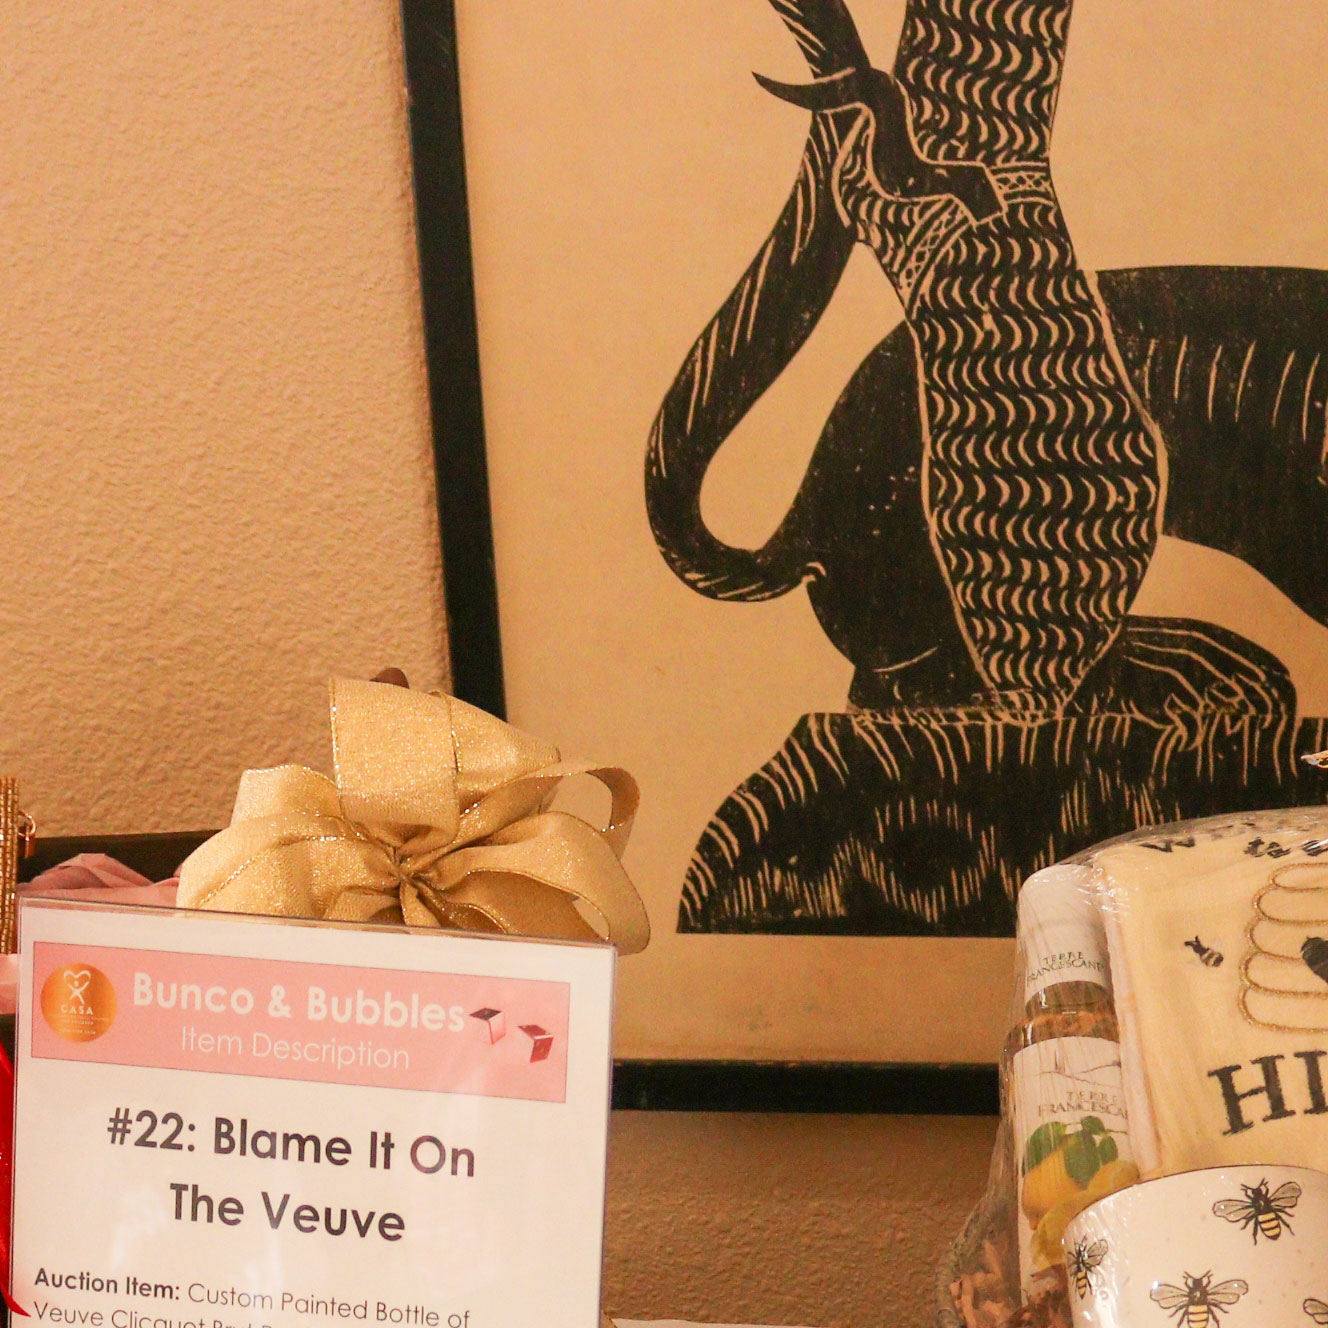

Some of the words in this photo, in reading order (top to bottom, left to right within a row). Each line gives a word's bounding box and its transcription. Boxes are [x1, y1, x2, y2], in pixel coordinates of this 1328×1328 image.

[133, 971, 254, 1016] Bunco
[269, 983, 292, 1019] &
[307, 985, 465, 1033] Bubbles
[181, 1025, 242, 1056] Item
[253, 1032, 410, 1071] Description
[107, 1108, 196, 1153] #22:
[213, 1117, 352, 1167] Blame
[370, 1130, 395, 1170] It
[410, 1135, 476, 1177] On
[170, 1183, 244, 1225] The
[261, 1193, 406, 1242] Veuve
[34, 1268, 119, 1295] Auction
[125, 1276, 180, 1301] Item:
[188, 1283, 272, 1310] Custom
[281, 1292, 367, 1321] Painted
[375, 1302, 440, 1328] Bottle
[34, 1302, 104, 1327] Veuve
